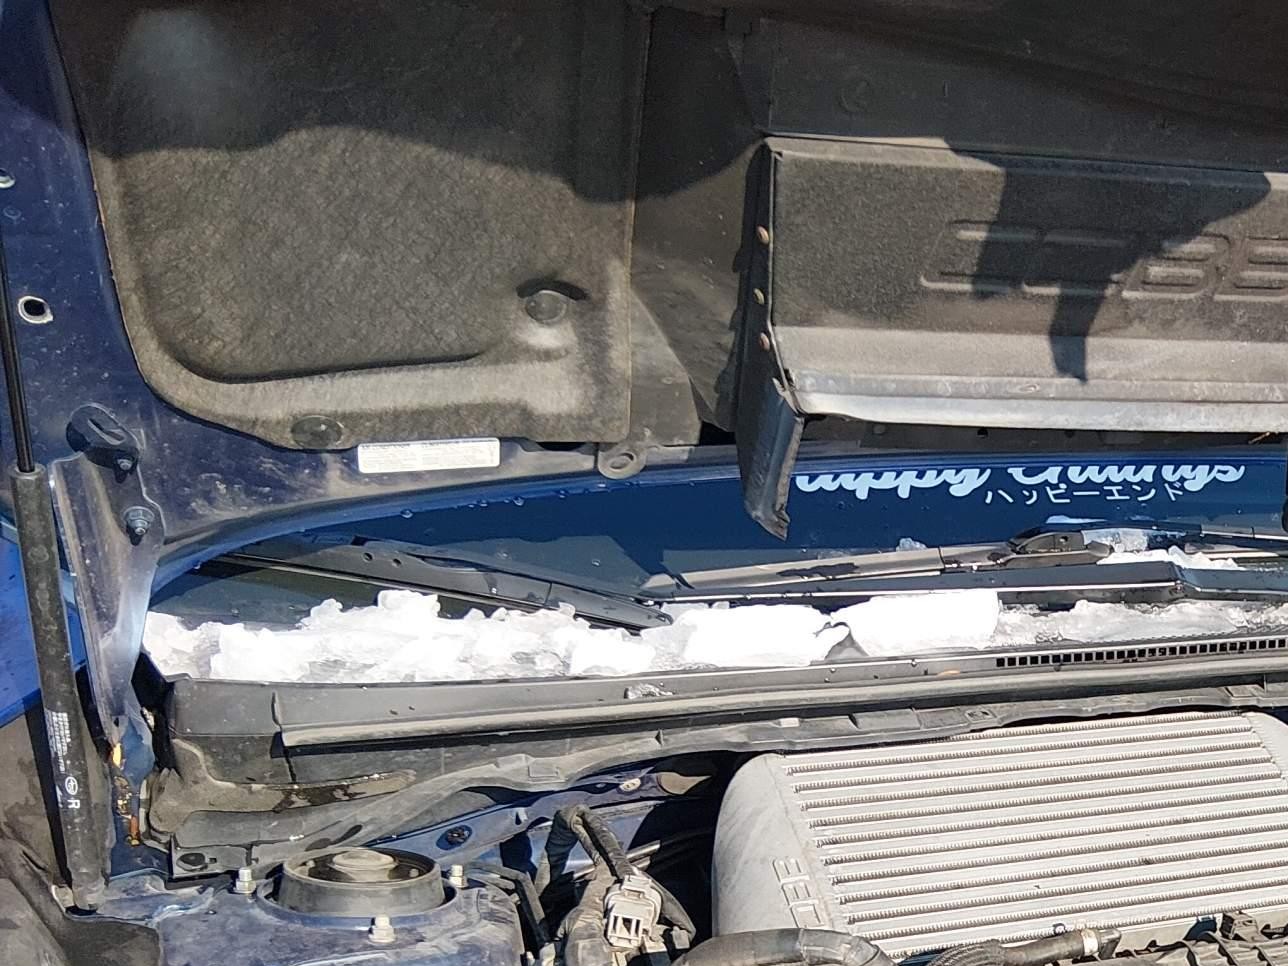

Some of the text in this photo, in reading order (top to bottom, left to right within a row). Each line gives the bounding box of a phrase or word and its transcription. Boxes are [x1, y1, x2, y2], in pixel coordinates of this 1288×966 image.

[984, 481, 1185, 505] ハッピーエンド
[67, 799, 80, 810] R
